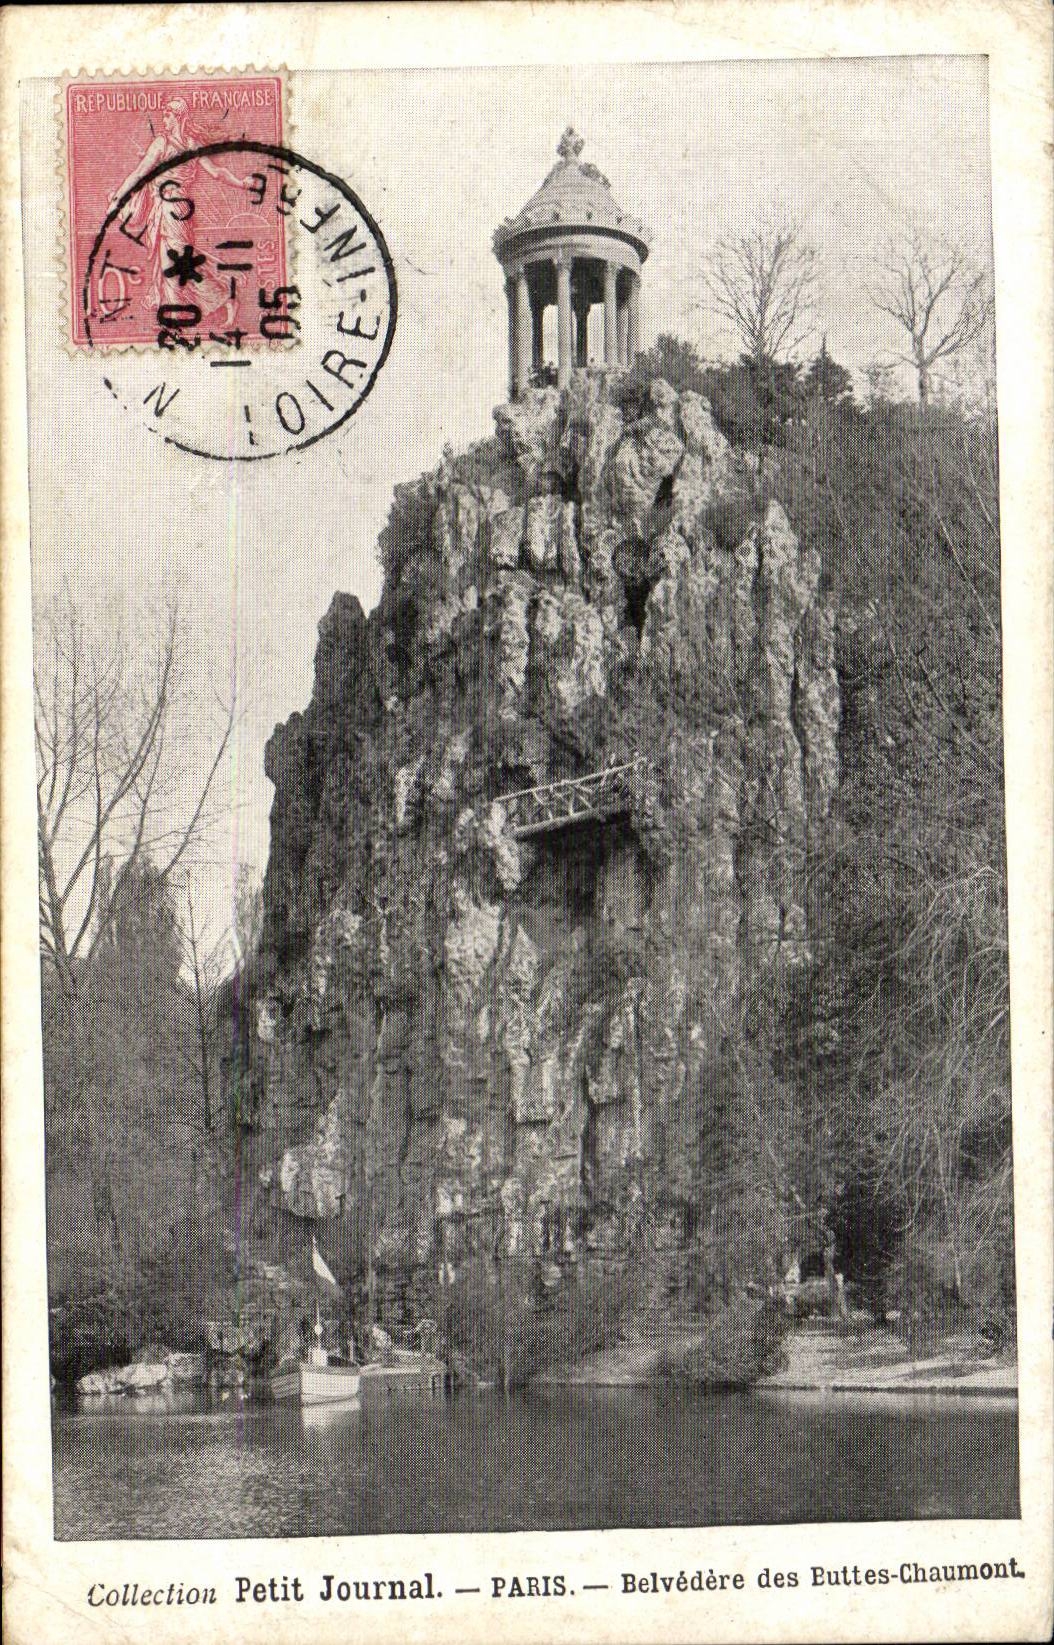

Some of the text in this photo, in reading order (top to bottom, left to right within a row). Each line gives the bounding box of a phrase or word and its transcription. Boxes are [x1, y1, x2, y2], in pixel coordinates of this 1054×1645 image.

[191, 88, 273, 110] FRANÇAISE
[99, 178, 196, 417] NNTES
[256, 238, 276, 322] STES
[258, 284, 302, 340] 05
[87, 1582, 217, 1607] Collection
[235, 1575, 304, 1603] Petit
[319, 1572, 443, 1602] Journal.
[491, 1575, 575, 1598] PARIS.
[620, 1569, 746, 1594] Belvédère
[757, 1568, 799, 1589] des
